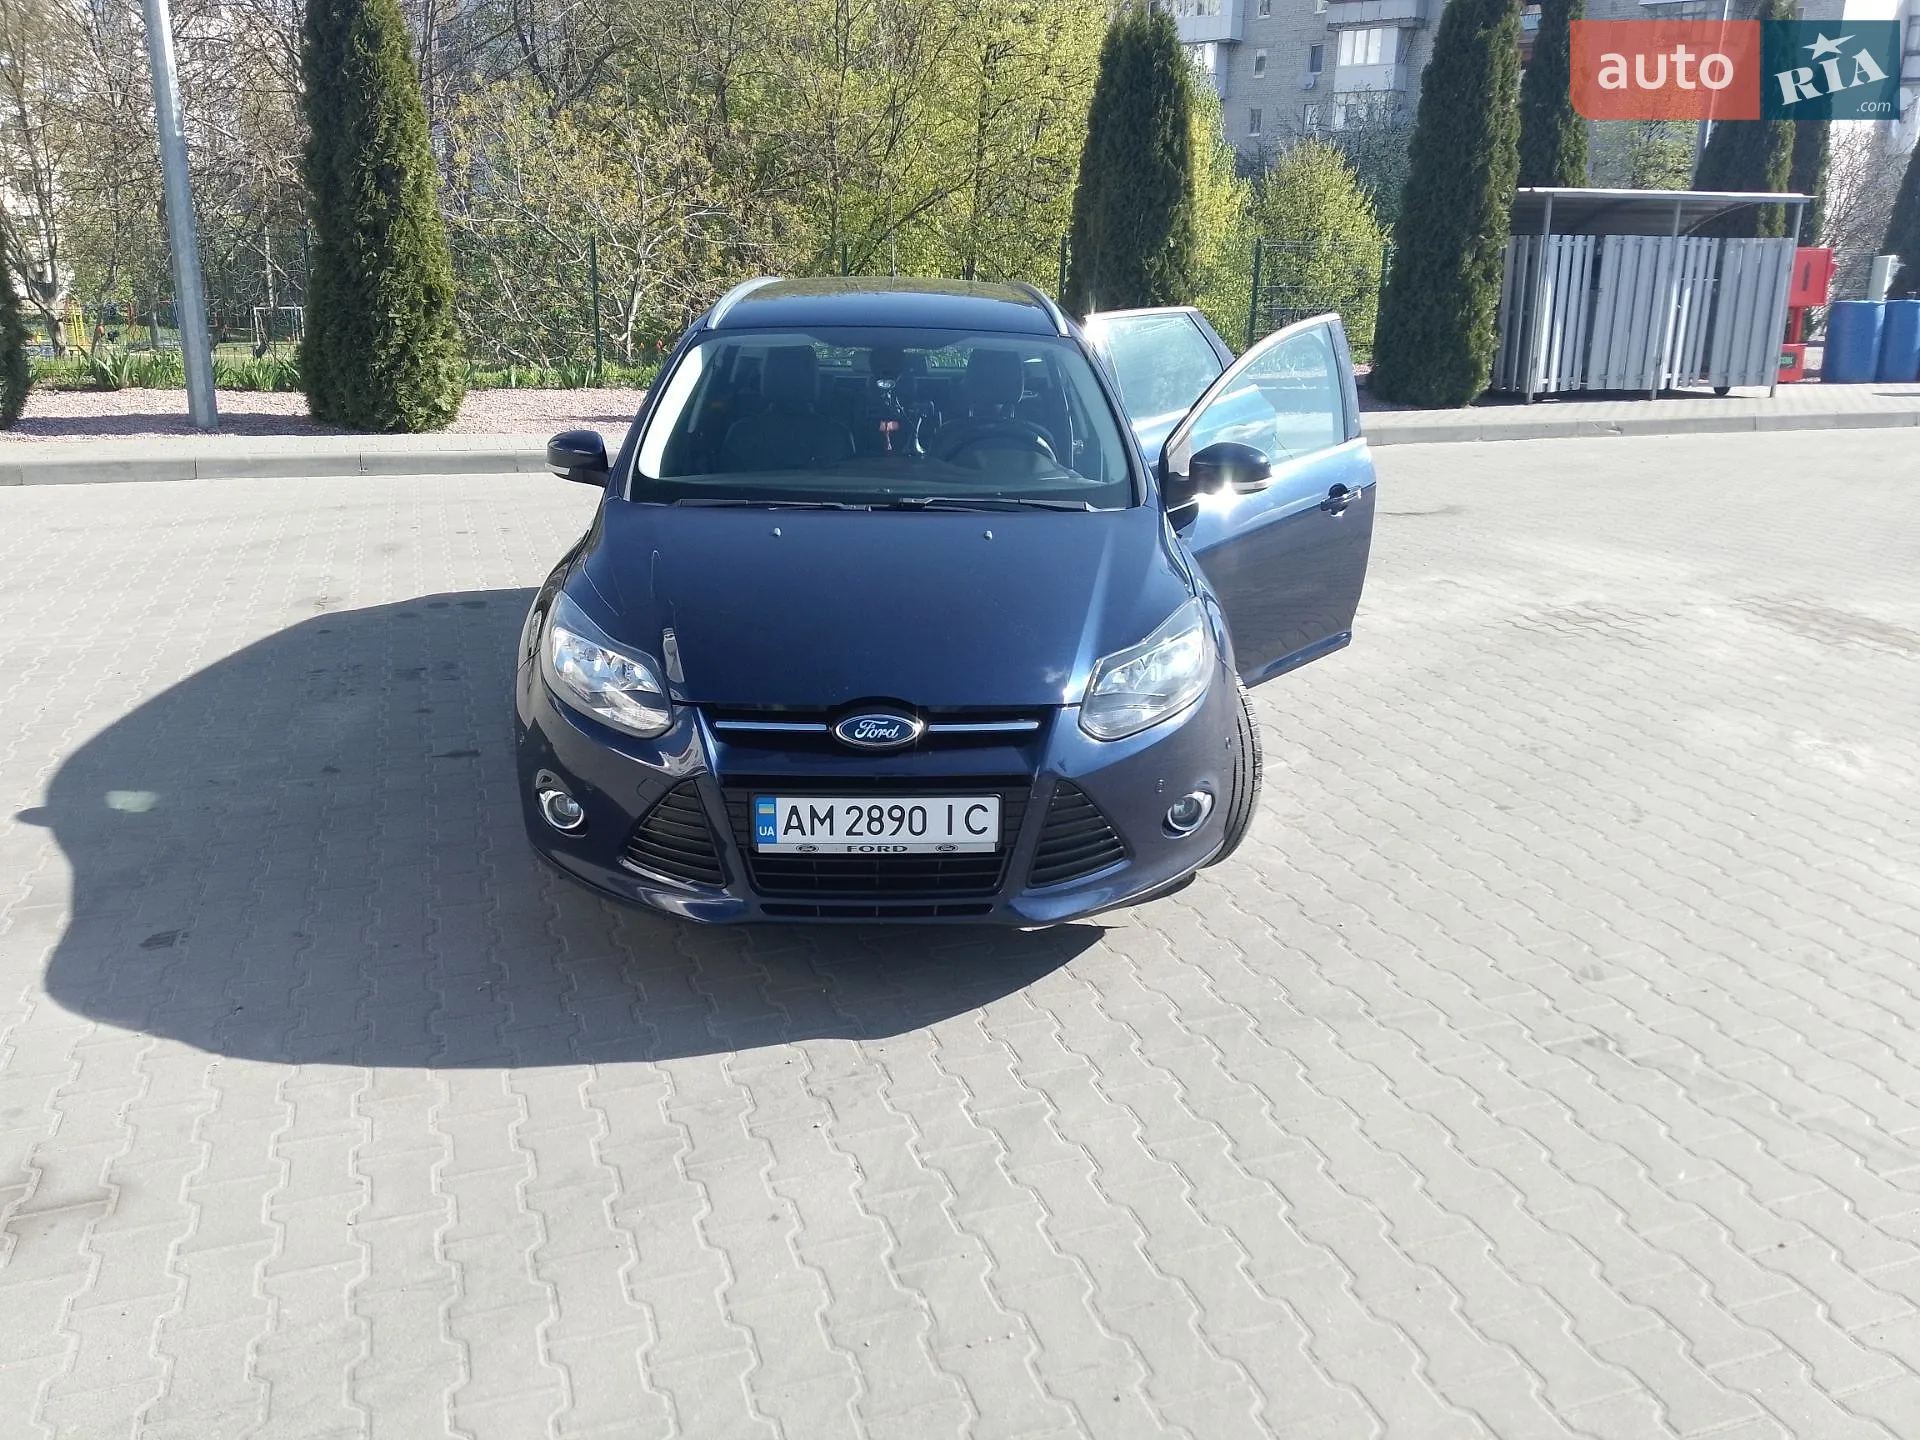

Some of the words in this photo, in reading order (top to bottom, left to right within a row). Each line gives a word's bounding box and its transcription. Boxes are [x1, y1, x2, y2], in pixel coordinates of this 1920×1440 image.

[854, 719, 900, 739] Ford
[783, 804, 834, 836] AM
[845, 804, 927, 836] 2890
[947, 803, 989, 835] IC
[759, 826, 775, 836] UA
